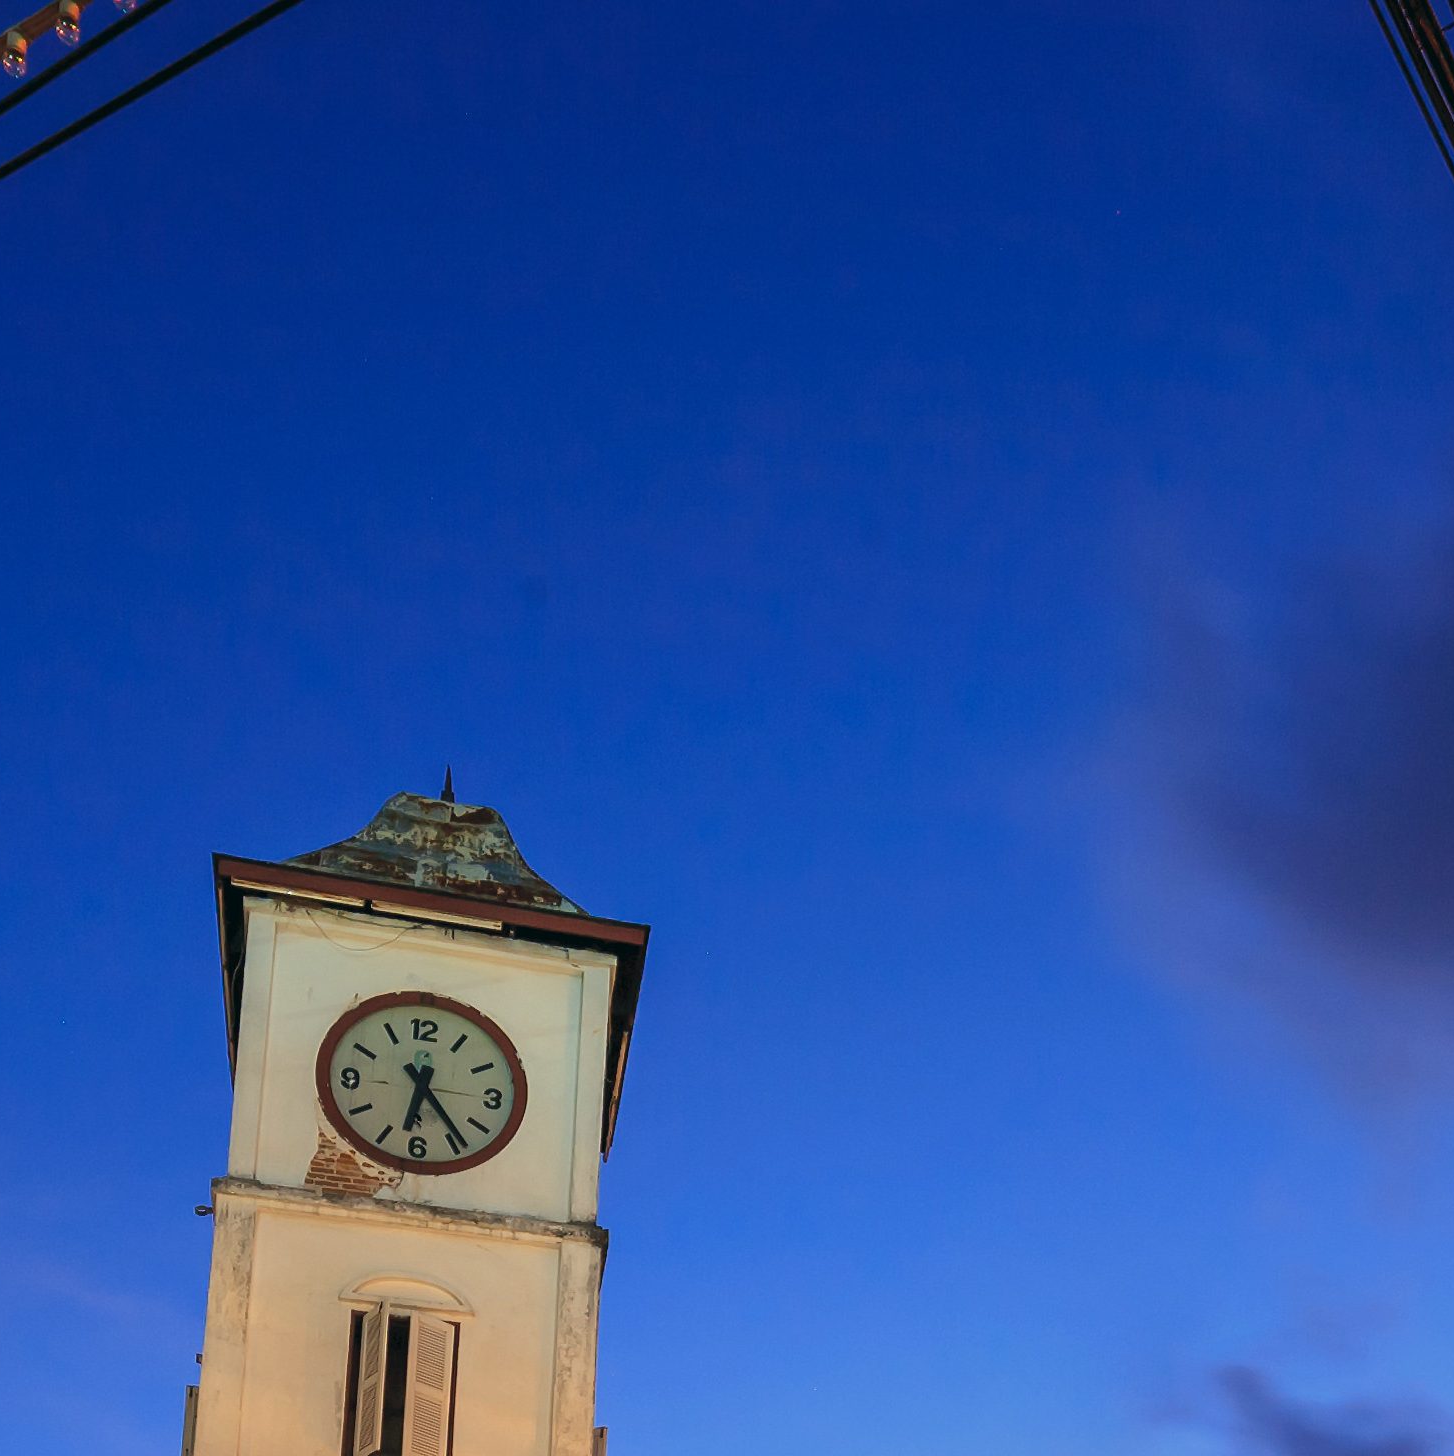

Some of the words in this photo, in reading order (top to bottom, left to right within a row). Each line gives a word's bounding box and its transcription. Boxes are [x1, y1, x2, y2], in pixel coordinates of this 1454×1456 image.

[410, 1018, 438, 1042] 12
[340, 1067, 360, 1090] 9
[483, 1088, 503, 1110] 3
[407, 1136, 427, 1159] 6
